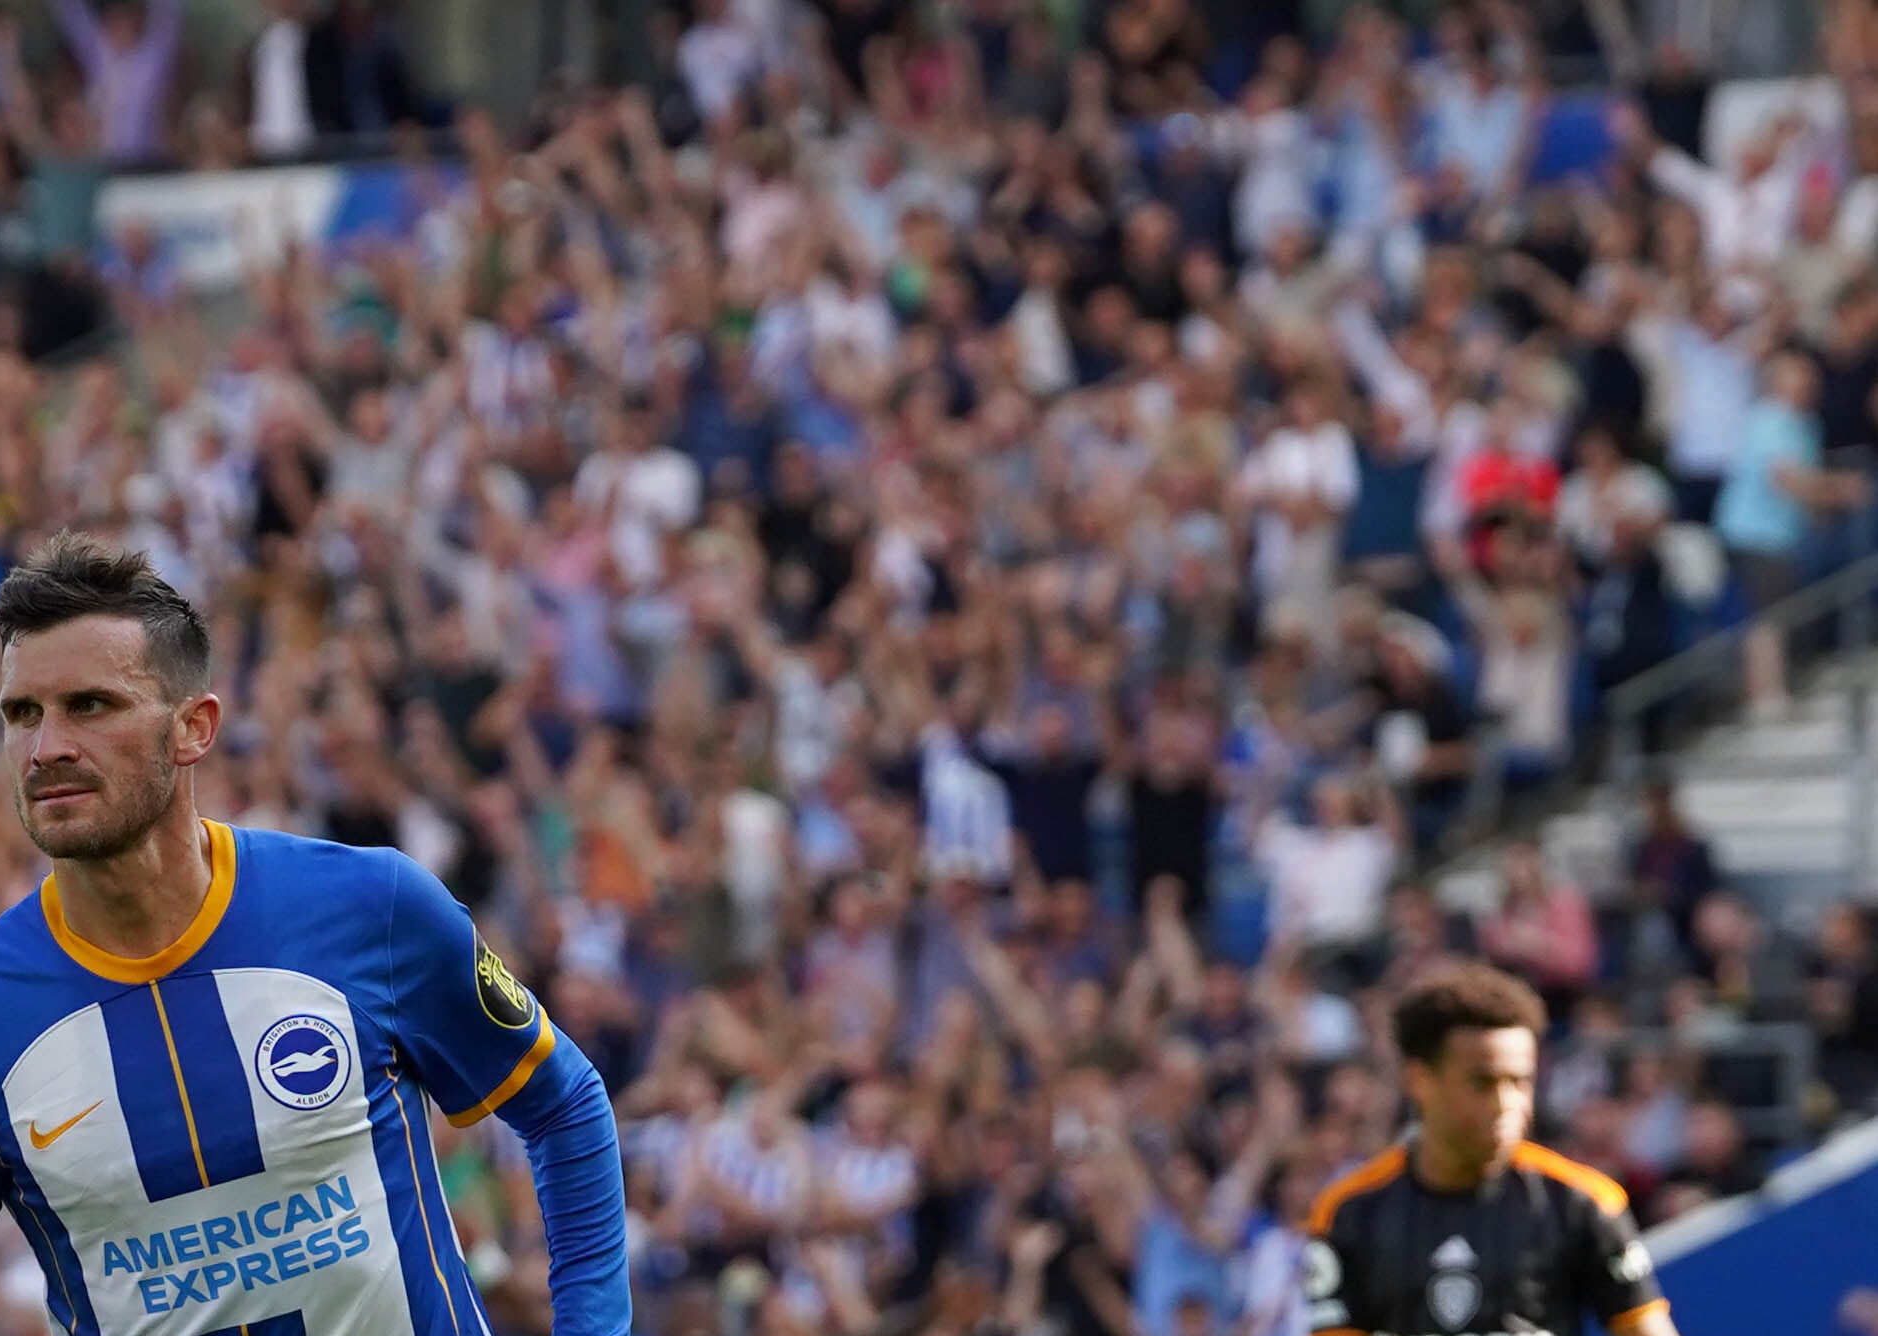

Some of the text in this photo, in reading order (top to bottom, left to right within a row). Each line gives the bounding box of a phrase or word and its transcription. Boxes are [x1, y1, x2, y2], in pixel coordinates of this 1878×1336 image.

[262, 1018, 336, 1053] BRIGHTON & HOVE
[295, 1091, 331, 1106] ALBION
[103, 1175, 357, 1277] AMERICAN
[137, 1215, 371, 1315] EXPRESS
